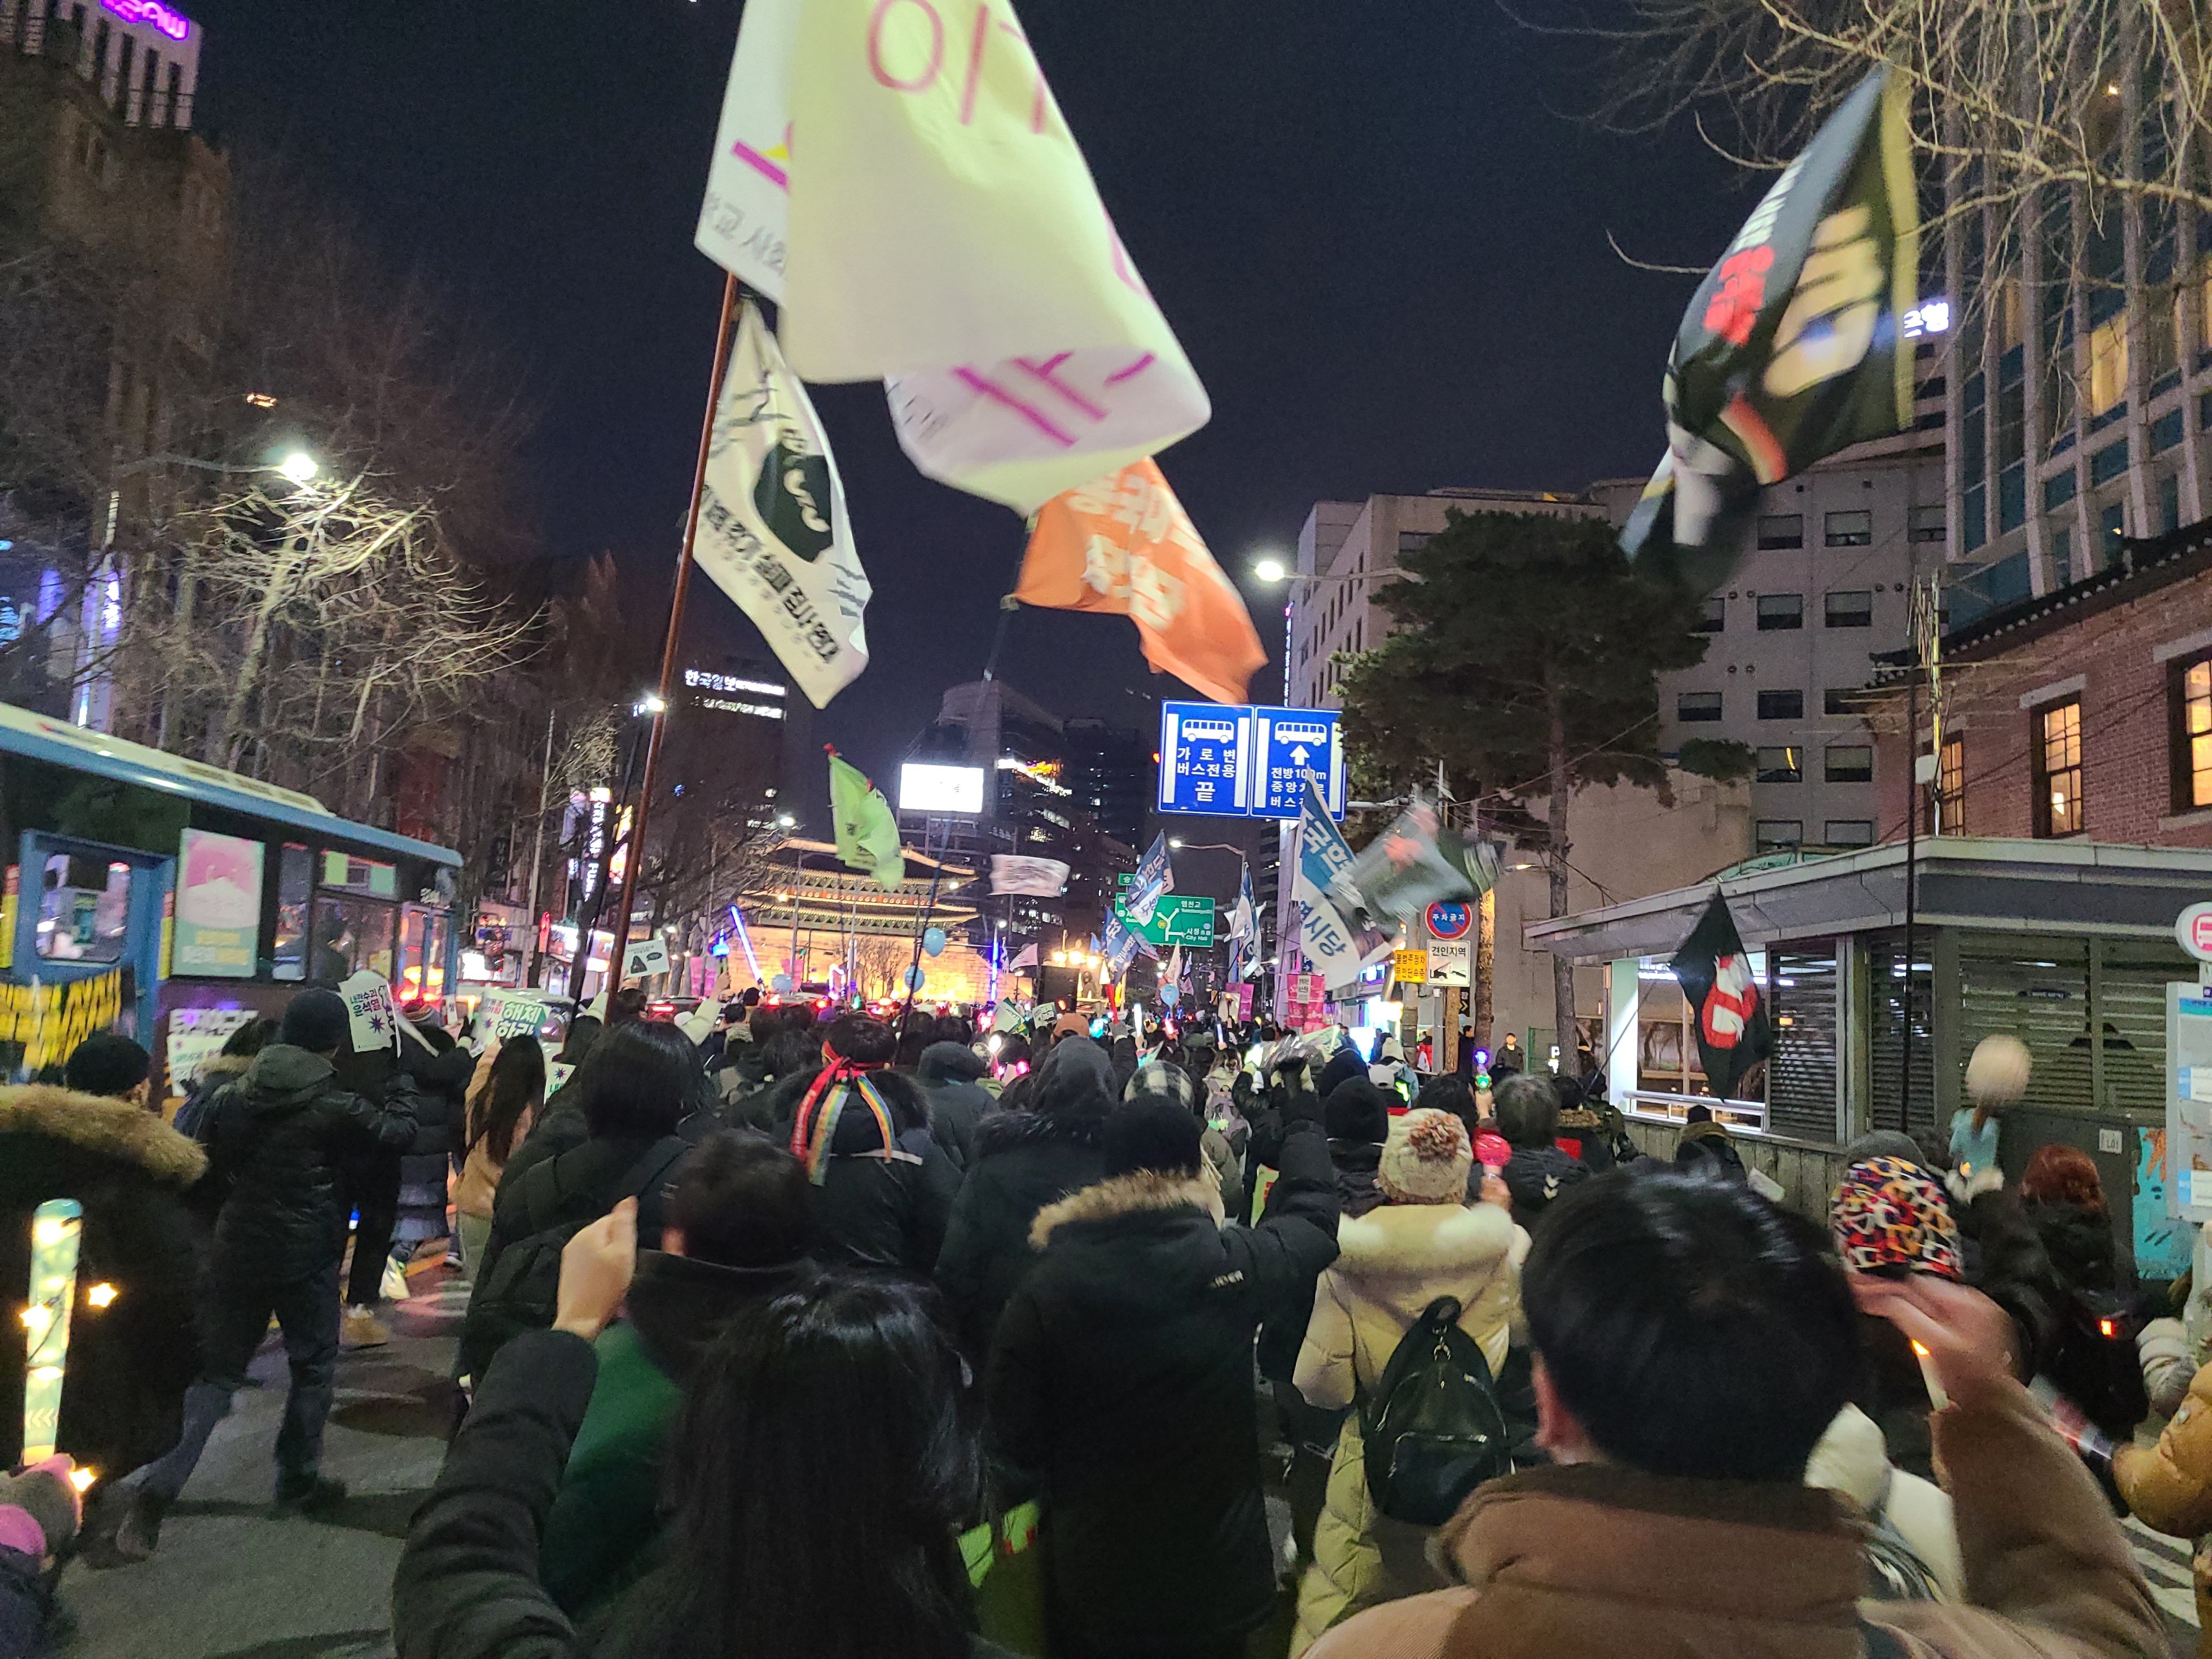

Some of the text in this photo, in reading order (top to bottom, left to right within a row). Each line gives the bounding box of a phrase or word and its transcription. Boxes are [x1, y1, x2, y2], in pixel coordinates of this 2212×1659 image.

[685, 670, 736, 691] 한국일보
[1177, 763, 1235, 778] 버스전용
[1195, 781, 1215, 802] 끝
[1432, 913, 1465, 922] 주차금지
[1396, 953, 1425, 965] 불법주정차
[1431, 946, 1466, 957] 견인지역
[1396, 967, 1425, 979] 무인단속중
[350, 988, 378, 1004] 내란수괴
[353, 998, 381, 1018] 윤석열
[502, 1001, 543, 1024] 해체
